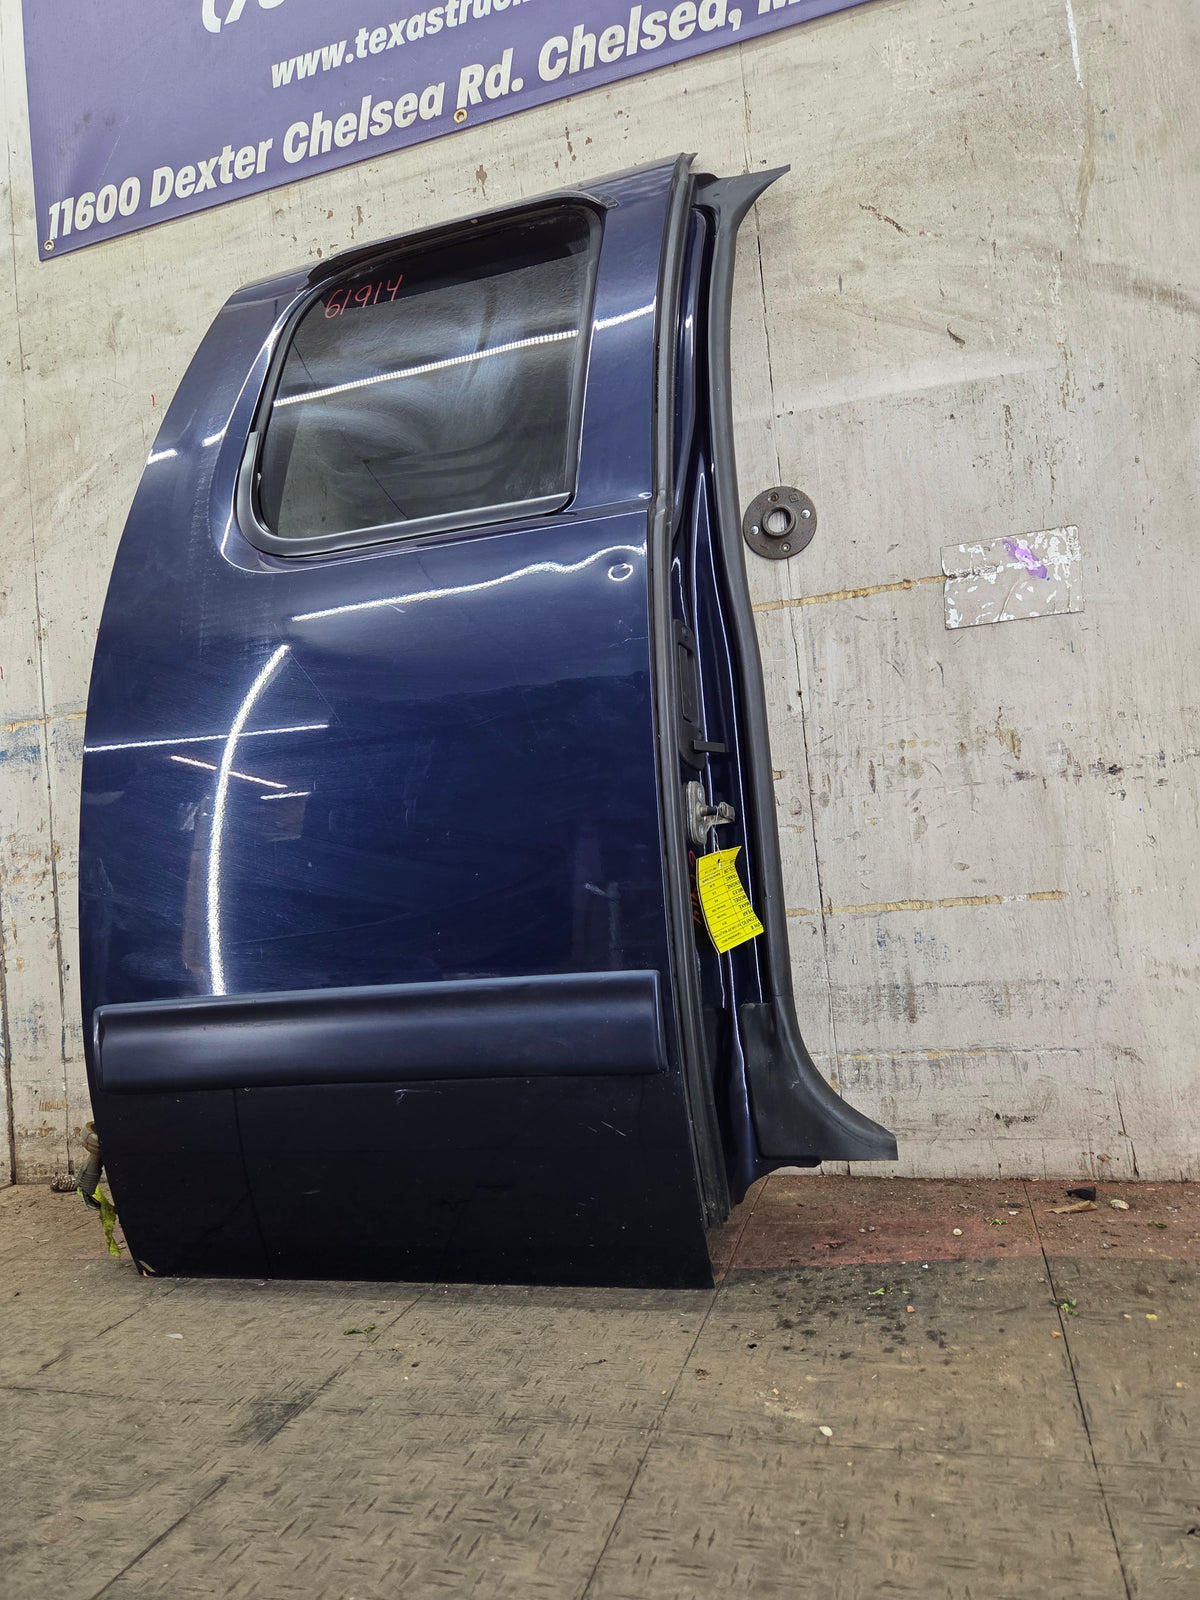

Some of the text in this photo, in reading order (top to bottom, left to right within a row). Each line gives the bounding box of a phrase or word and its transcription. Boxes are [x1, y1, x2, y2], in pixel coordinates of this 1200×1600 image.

[271, 0, 531, 88] www.texastru
[48, 0, 743, 241] 11600 Dexter Chelsea Rd. Chelsea,
[324, 274, 404, 319] 61914
[733, 894, 747, 904] MODEL
[741, 915, 756, 926] CONFIG
